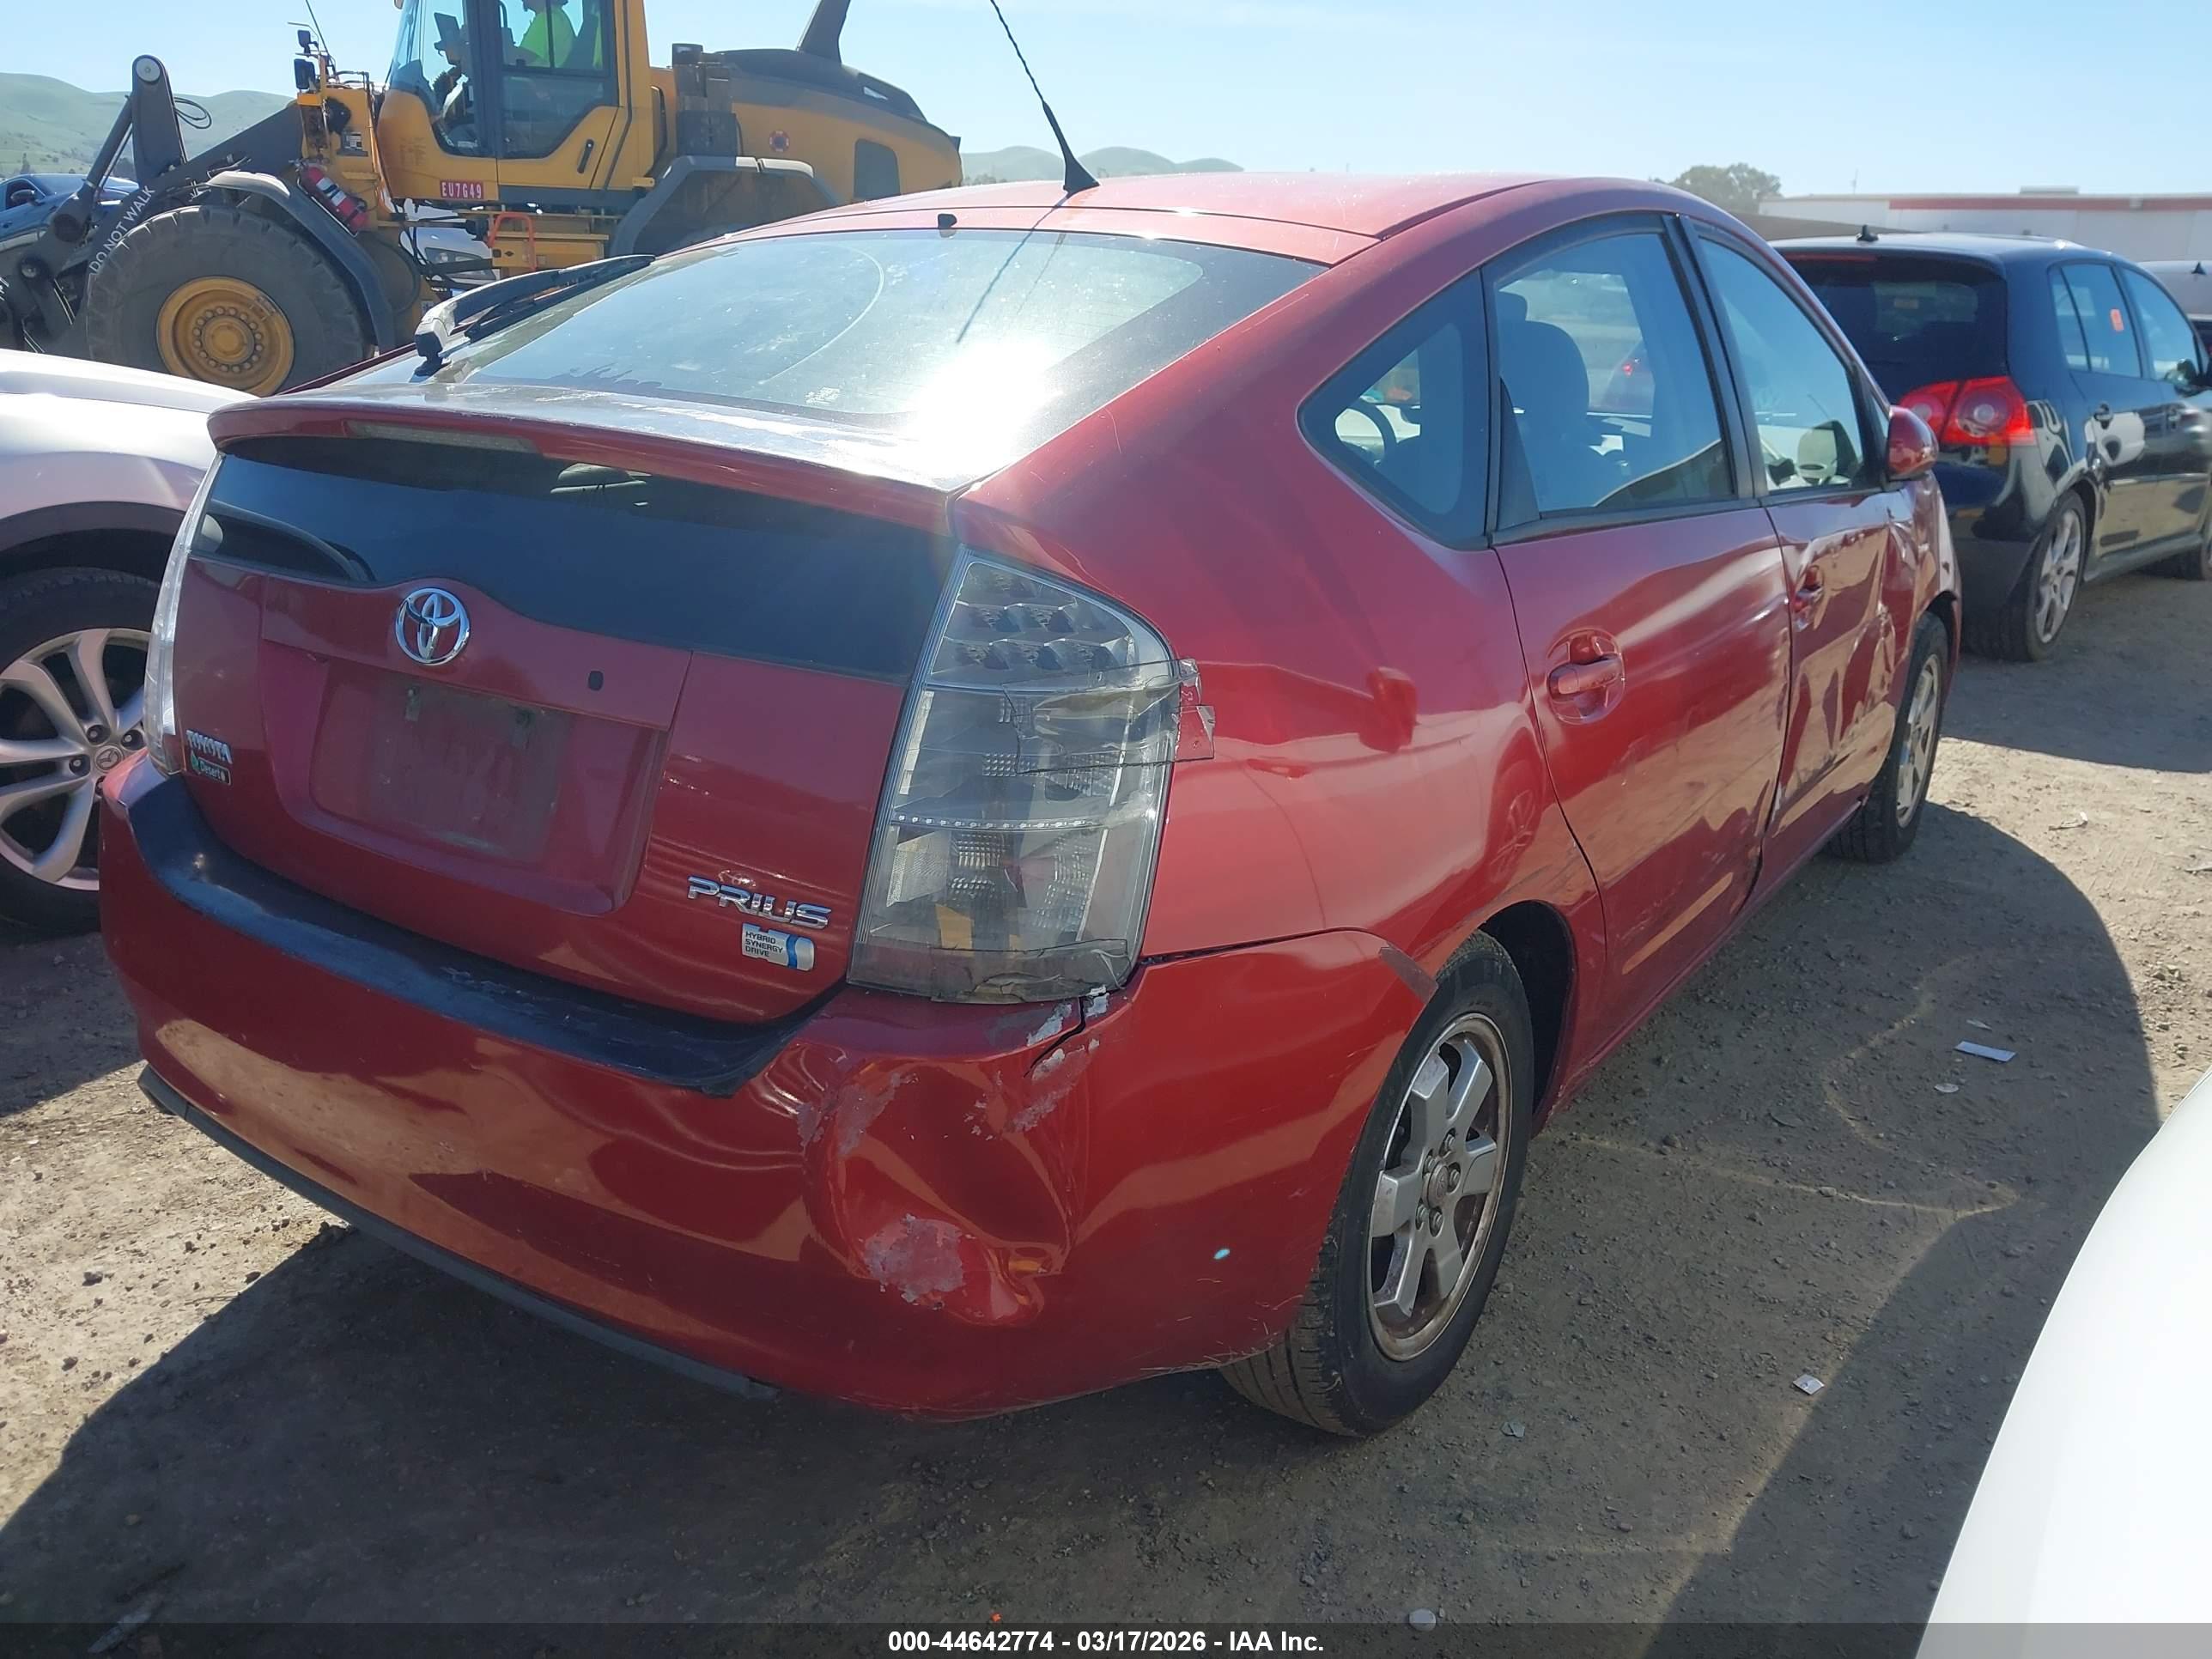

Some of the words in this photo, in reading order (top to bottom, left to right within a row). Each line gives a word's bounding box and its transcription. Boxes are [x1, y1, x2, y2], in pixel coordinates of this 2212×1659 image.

[441, 181, 482, 199] EU7G49
[88, 250, 108, 275] DO
[102, 221, 129, 252] NOT
[123, 185, 156, 222] WALK
[185, 729, 233, 764] TOYOTA
[688, 876, 832, 929] PRIUS
[744, 938, 784, 954] SYNERGY
[745, 931, 776, 945] HYBRID
[745, 945, 769, 957] DRIVE
